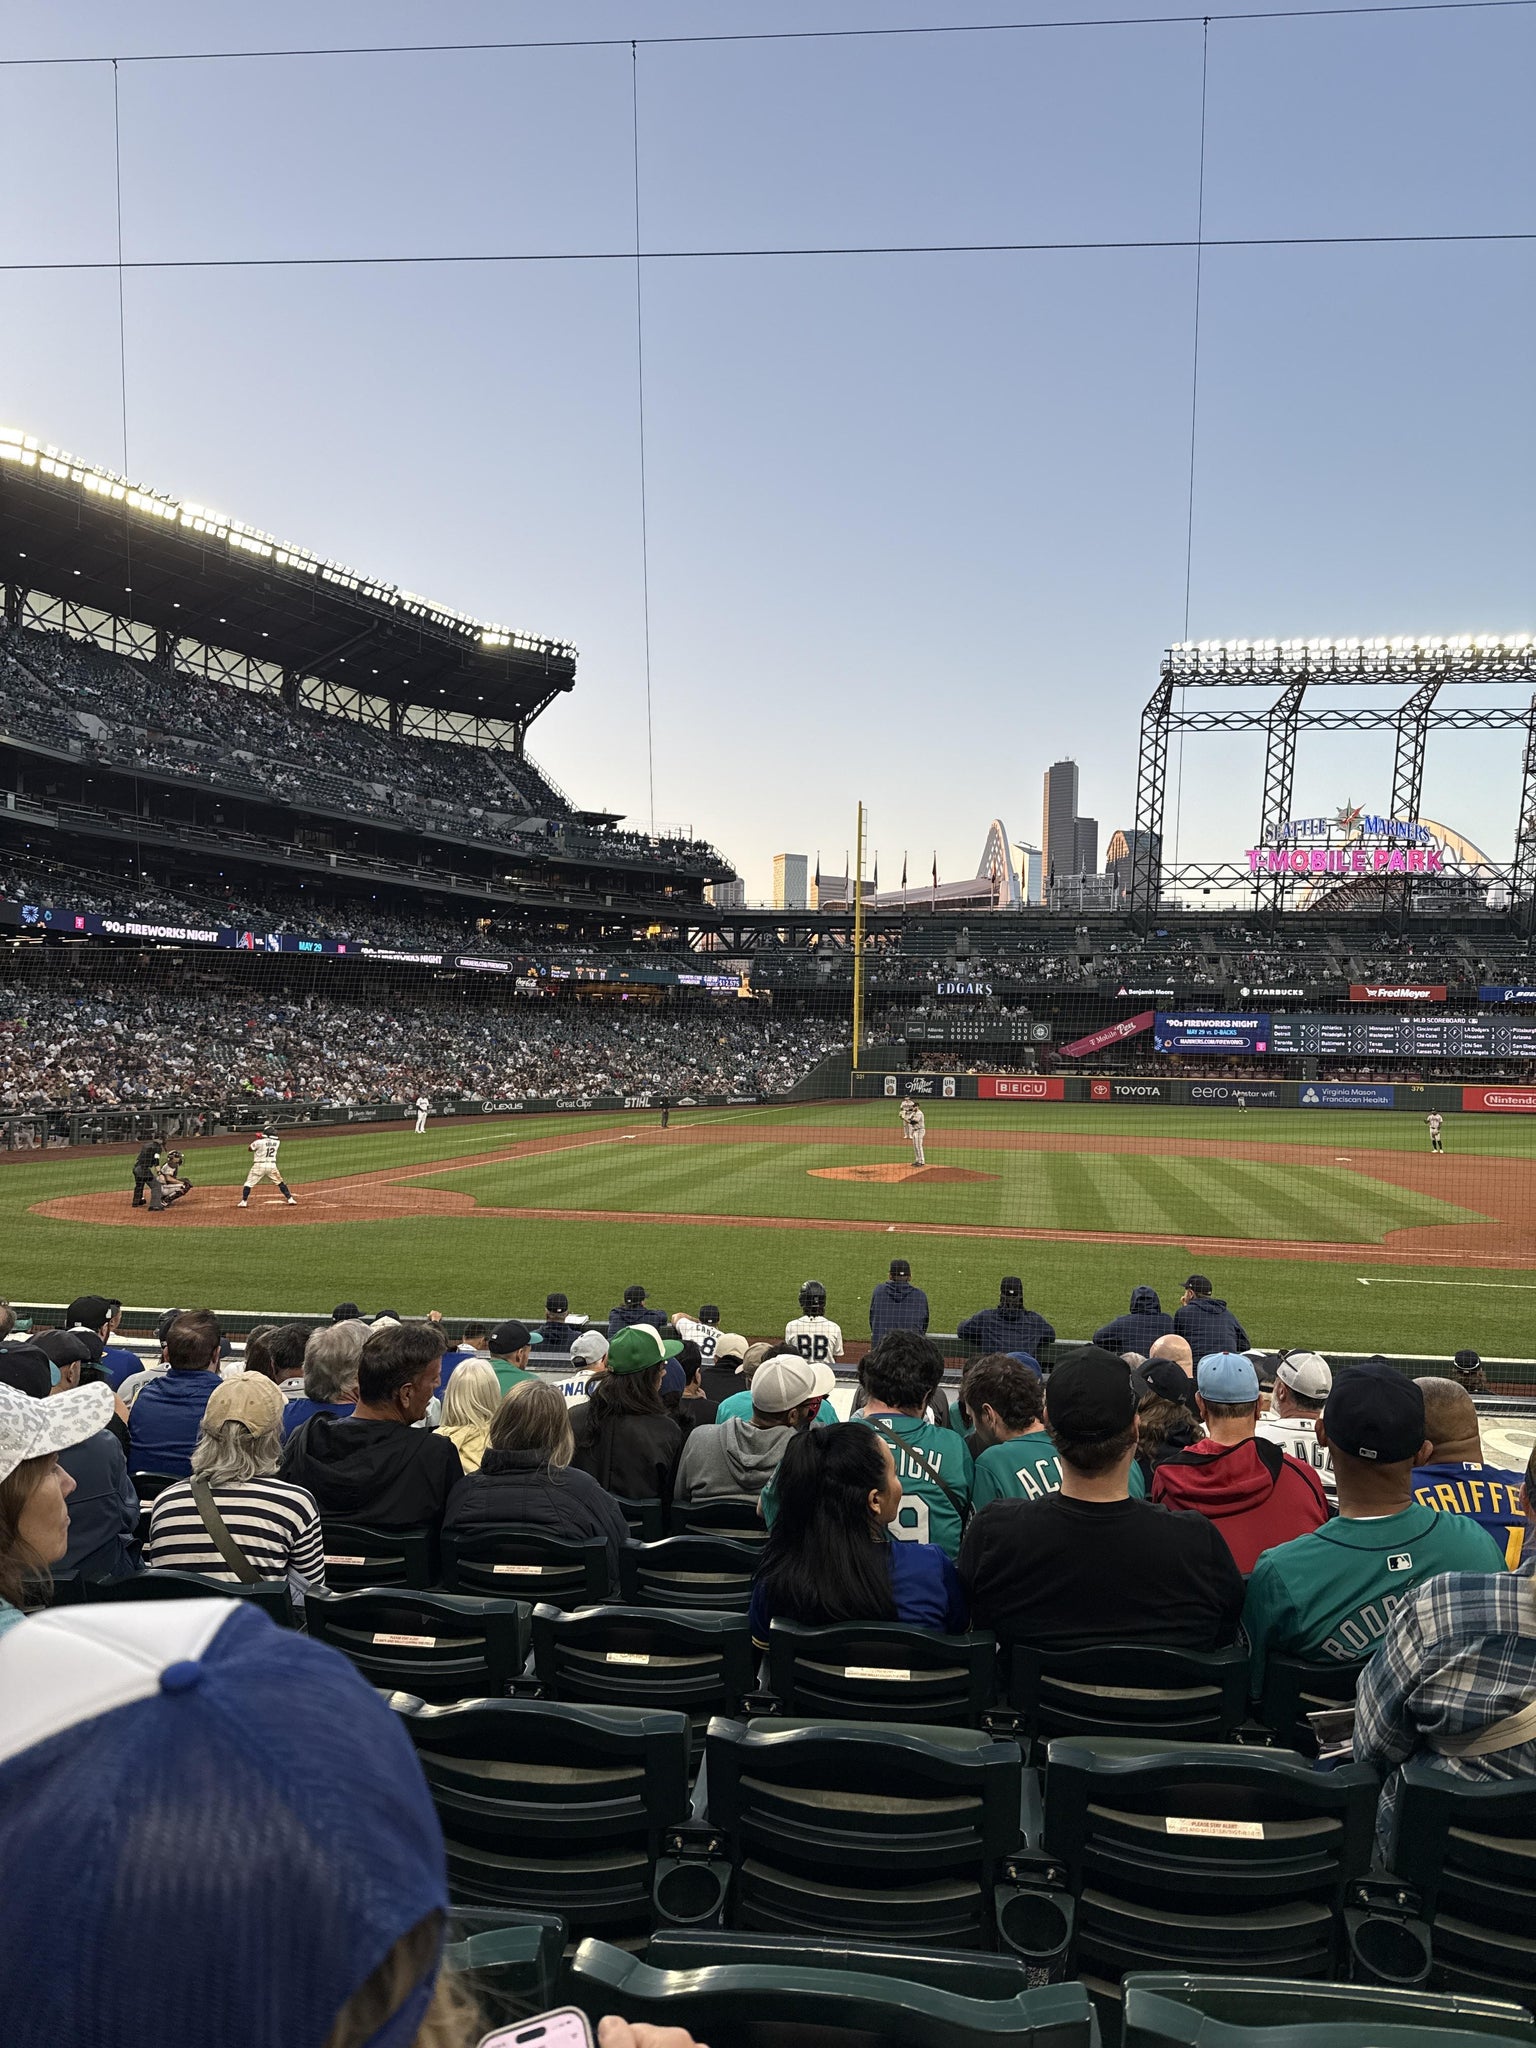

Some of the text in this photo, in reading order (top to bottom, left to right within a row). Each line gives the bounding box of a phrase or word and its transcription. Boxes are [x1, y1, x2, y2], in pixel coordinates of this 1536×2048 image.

[1265, 815, 1431, 843] SEATTLE MARINERS
[1245, 850, 1444, 872] T-MOBILE PARK
[125, 923, 185, 939] FIREWORKS
[186, 930, 218, 942] NIGHT
[299, 941, 322, 951] MAY 29
[420, 955, 442, 964] NIGHT
[1166, 1019, 1183, 1027] '90s
[1232, 1020, 1258, 1028] NIGHT
[1000, 1083, 1043, 1093] BECU
[1114, 1086, 1160, 1096] TOYOTA
[1191, 1087, 1229, 1098] eero
[1321, 1088, 1349, 1096] Virginia
[556, 1098, 593, 1109] Great Clips
[624, 1097, 651, 1108] STIHL
[265, 1148, 276, 1158] 12
[701, 1336, 716, 1356] 8
[797, 1334, 829, 1360] BB
[1277, 1440, 1334, 1472] AG
